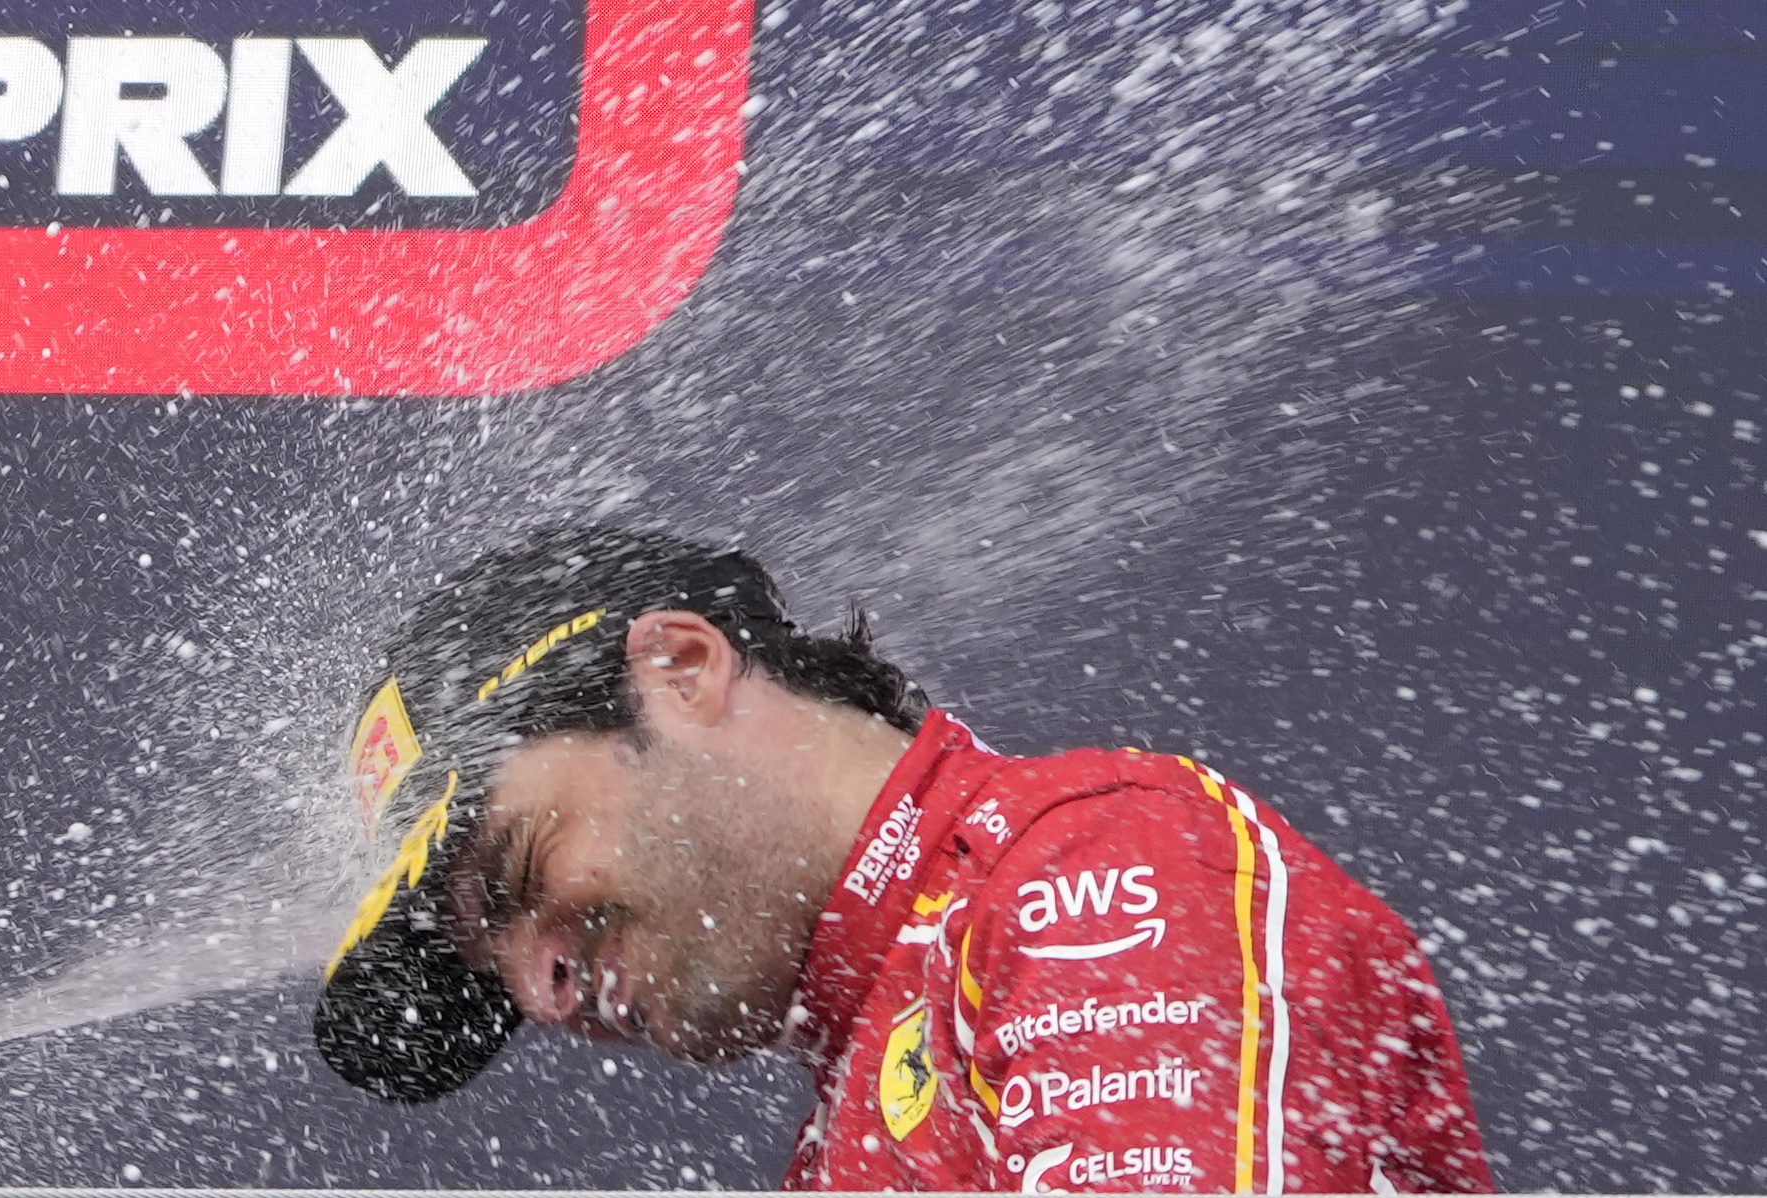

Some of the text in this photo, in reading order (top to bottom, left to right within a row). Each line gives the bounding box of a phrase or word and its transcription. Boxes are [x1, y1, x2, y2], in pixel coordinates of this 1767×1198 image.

[843, 792, 917, 901] PERONI
[1017, 864, 1160, 933] aws
[995, 991, 1207, 1057] Bitdefender
[1041, 1057, 1201, 1116] Palantir
[1068, 1146, 1193, 1185] CELSIUS
